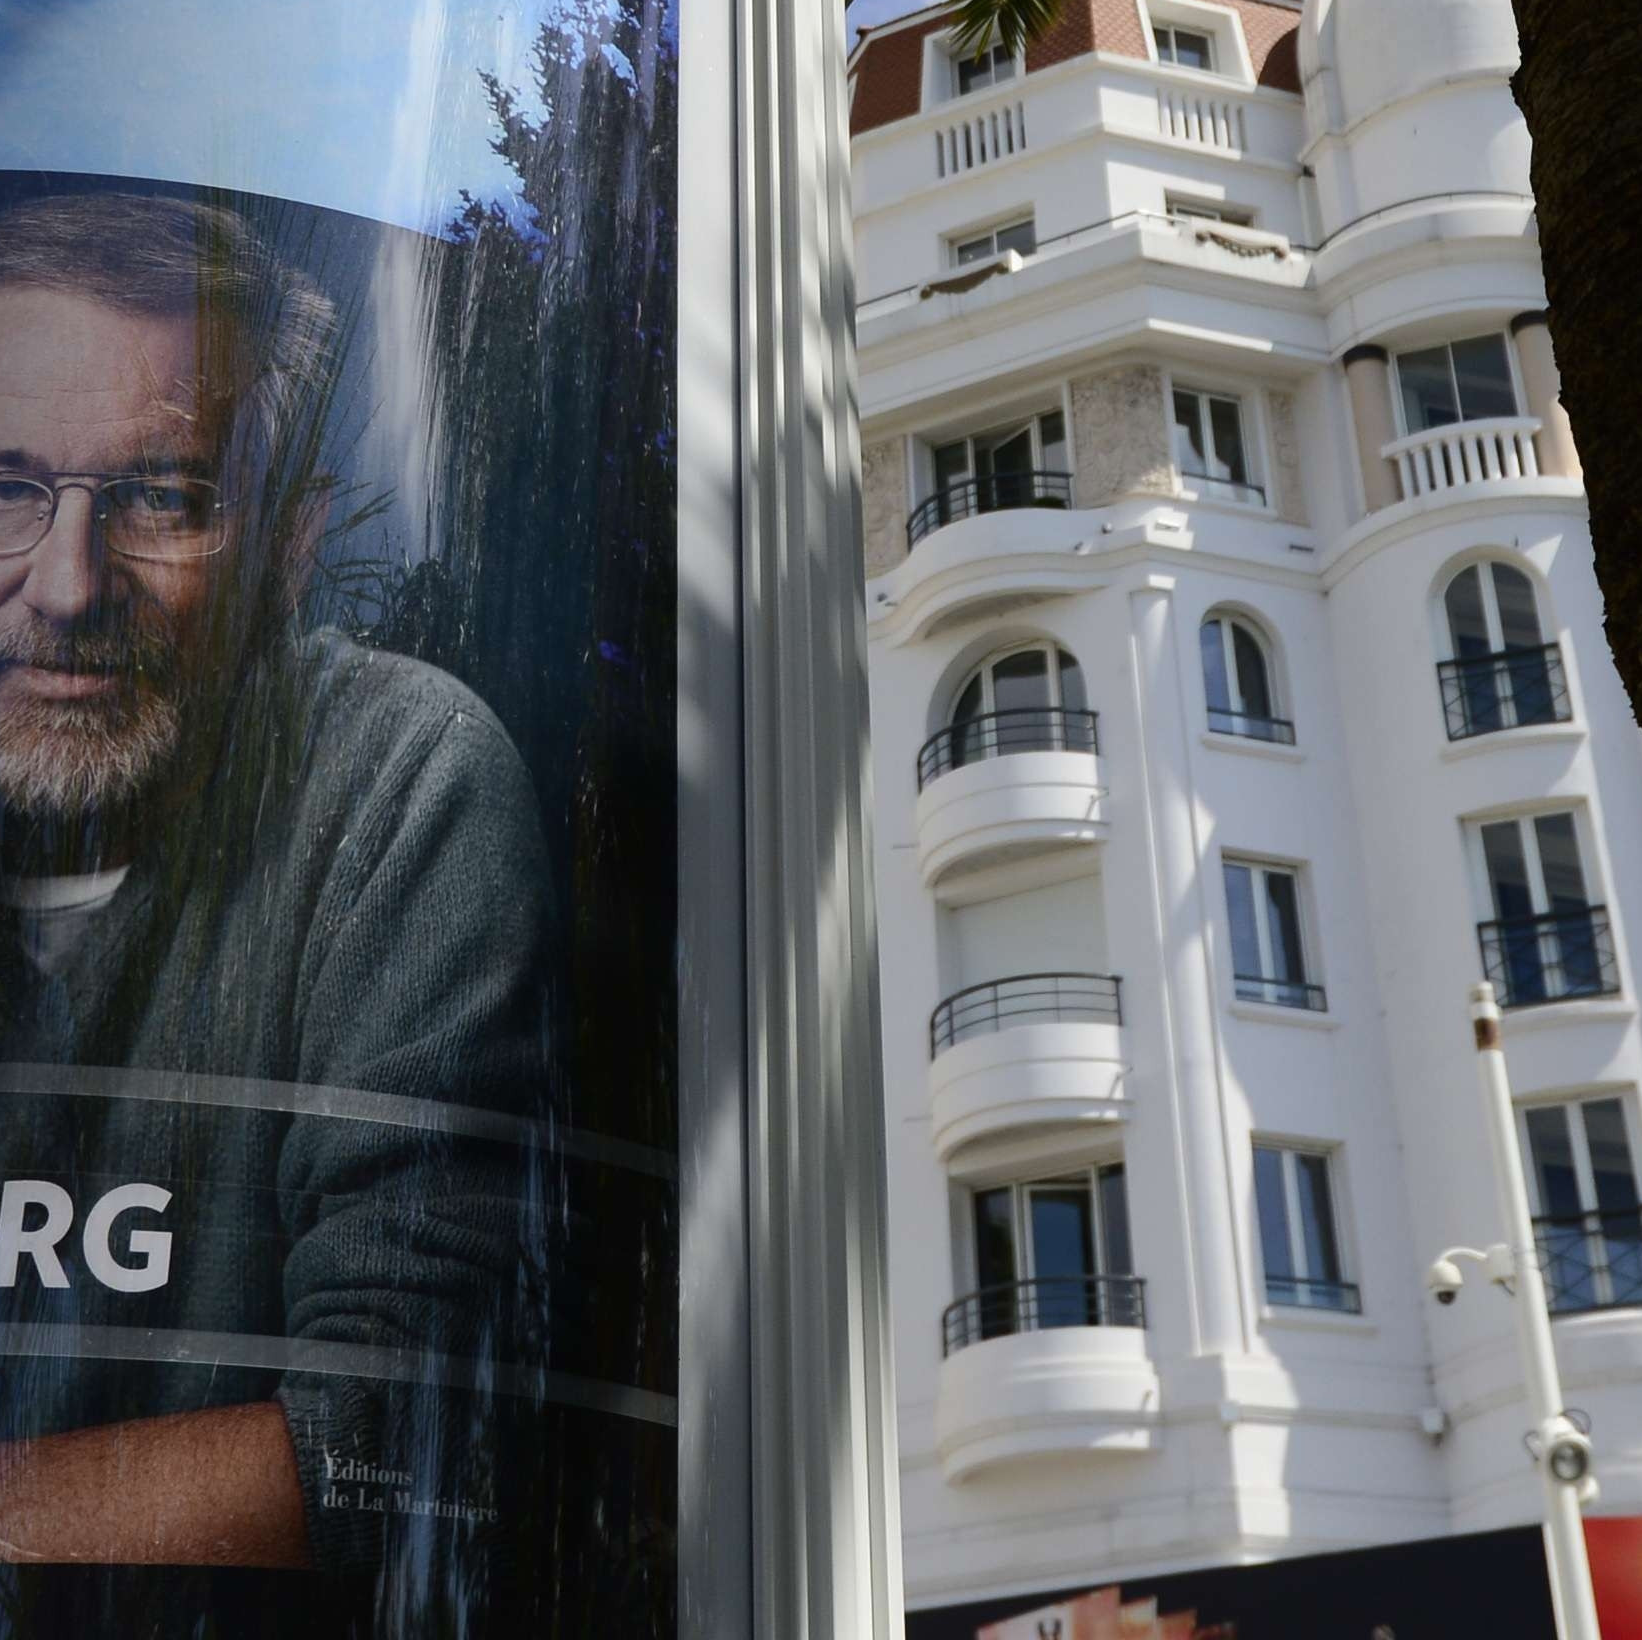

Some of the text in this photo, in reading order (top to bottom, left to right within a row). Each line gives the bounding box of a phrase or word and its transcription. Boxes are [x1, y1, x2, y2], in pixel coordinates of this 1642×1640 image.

[324, 1449, 413, 1486] Éditions
[323, 1486, 499, 1523] de La Martinière
